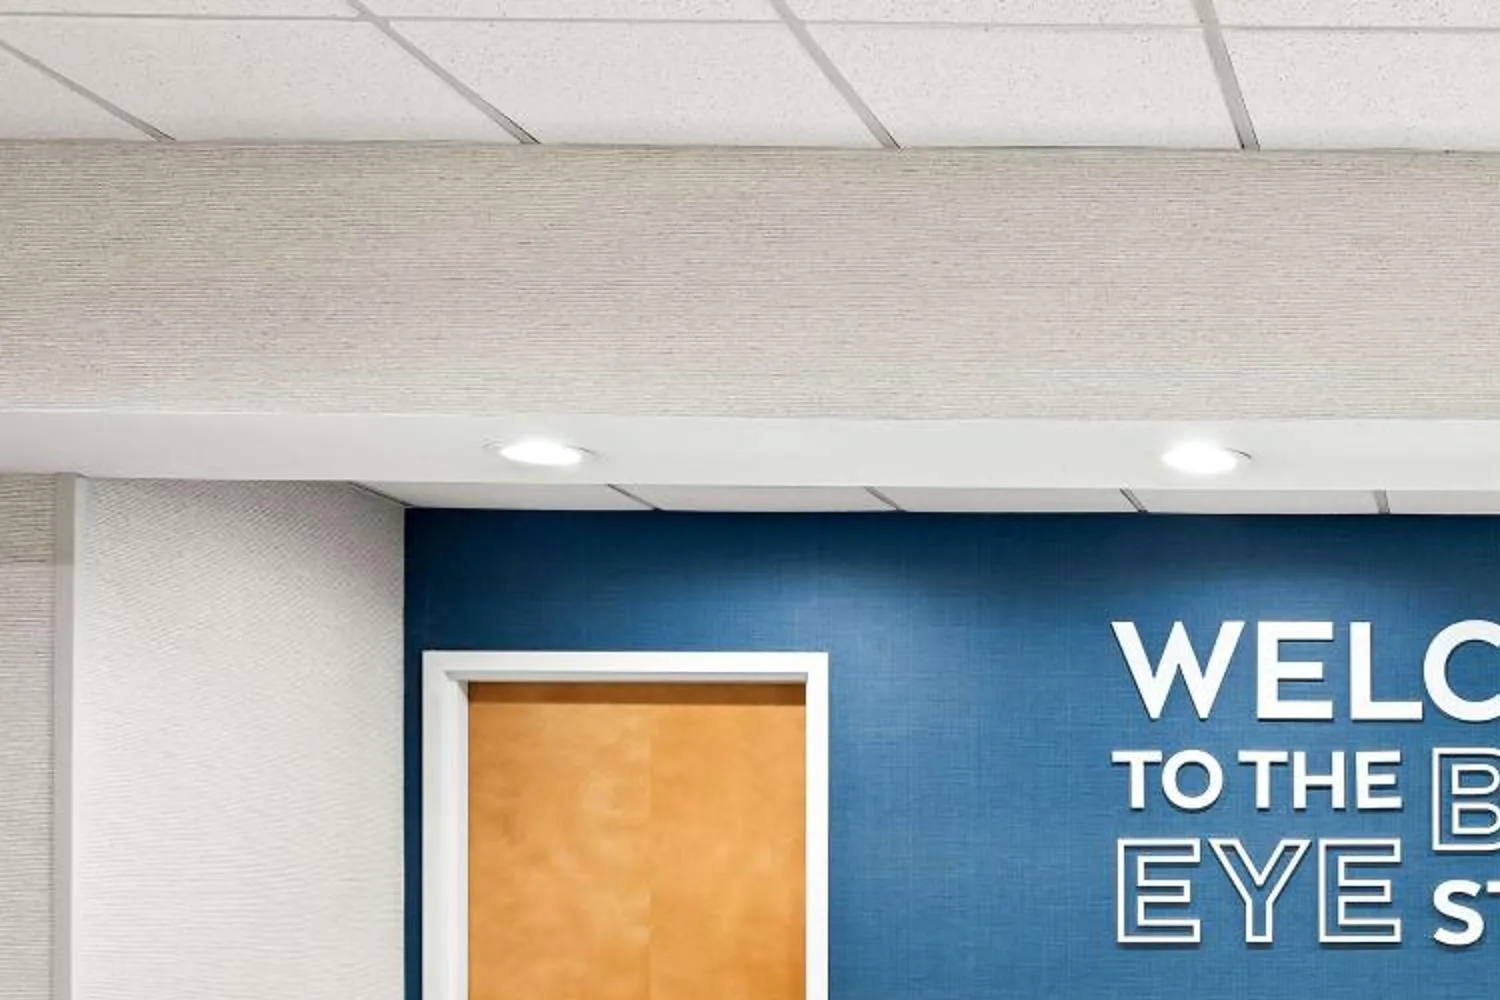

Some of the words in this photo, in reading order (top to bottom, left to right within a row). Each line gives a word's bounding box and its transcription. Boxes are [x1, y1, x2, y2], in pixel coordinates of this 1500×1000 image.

[1112, 749, 1223, 809] TO
[1238, 749, 1401, 809] THE
[1116, 838, 1401, 944] EYE
